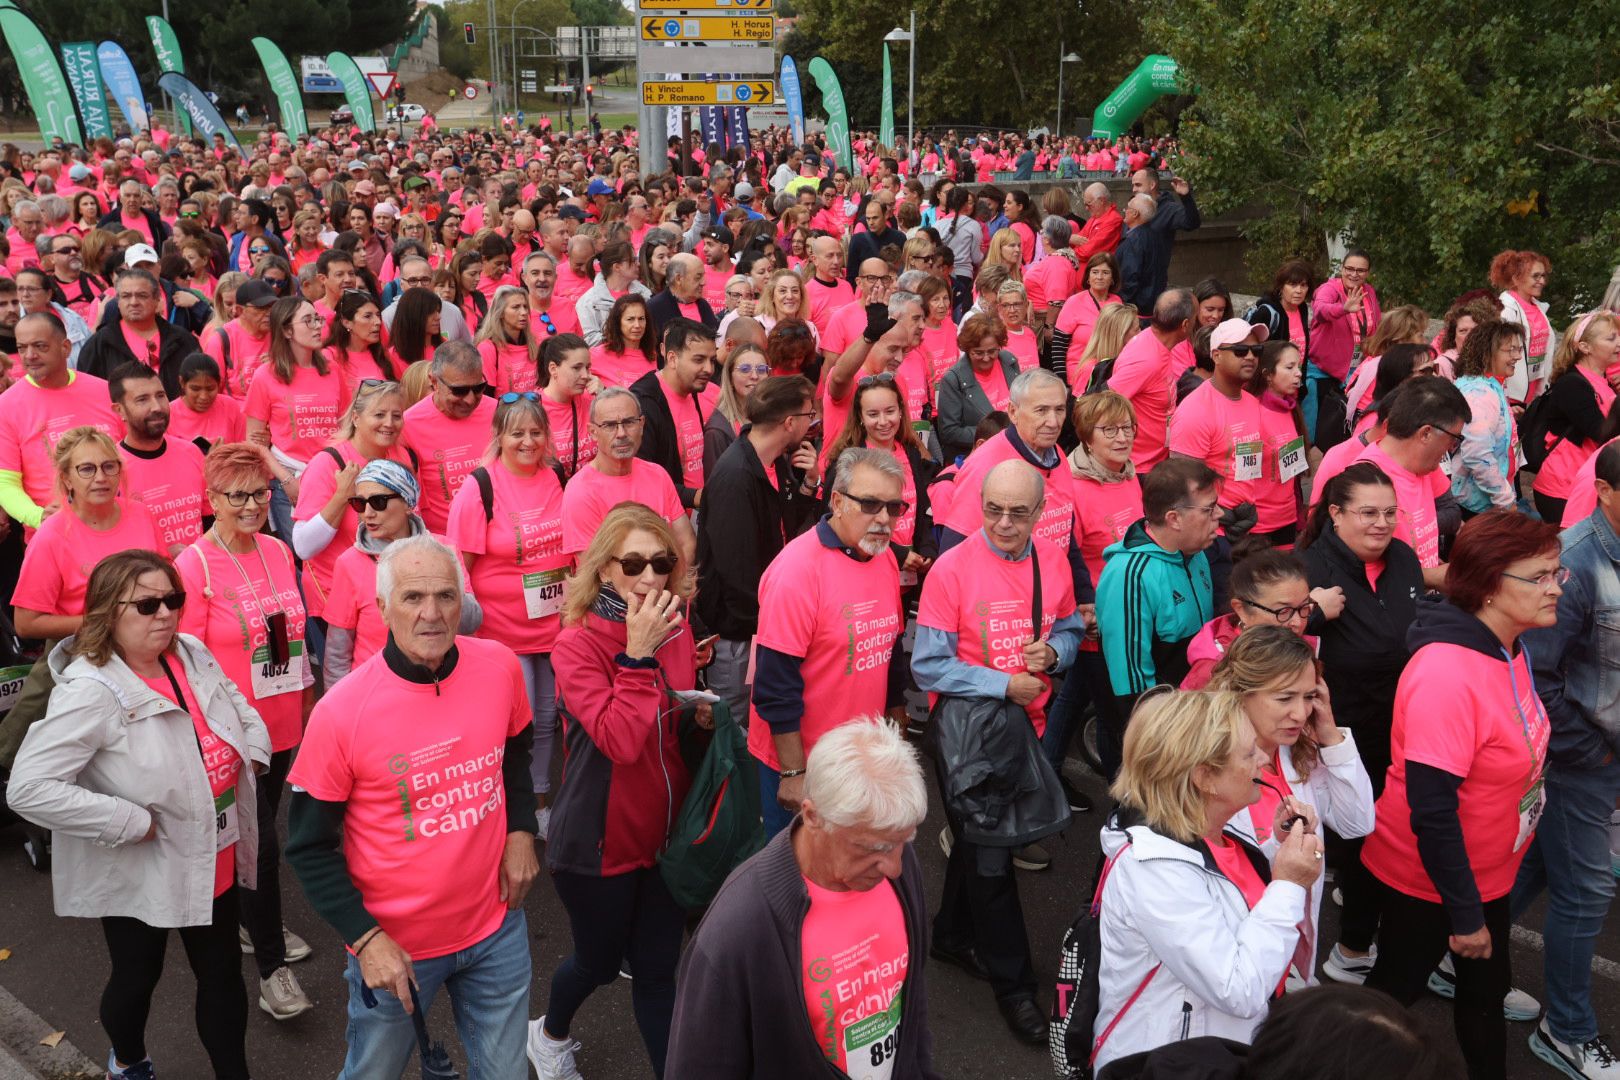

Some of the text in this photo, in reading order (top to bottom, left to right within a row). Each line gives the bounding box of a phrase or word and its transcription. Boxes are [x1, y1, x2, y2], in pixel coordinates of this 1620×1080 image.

[746, 30, 770, 38] Regio
[645, 85, 684, 93] H. Vincci
[295, 405, 338, 414] En march
[297, 416, 331, 426] contra
[446, 461, 462, 472] En
[1243, 455, 1257, 467] 7485
[1282, 452, 1299, 468] 5223
[158, 510, 195, 528] ontra
[522, 518, 561, 535] En mar
[540, 583, 563, 600] 4274
[855, 613, 898, 635] En march
[990, 619, 1008, 632] En
[856, 632, 892, 653] contra
[855, 646, 893, 672] cánce
[262, 661, 289, 678] 4032
[0, 679, 24, 698] 927
[412, 772, 440, 792] En
[415, 776, 494, 811] contra
[419, 784, 502, 838] cáncer
[836, 951, 908, 1003] En marc
